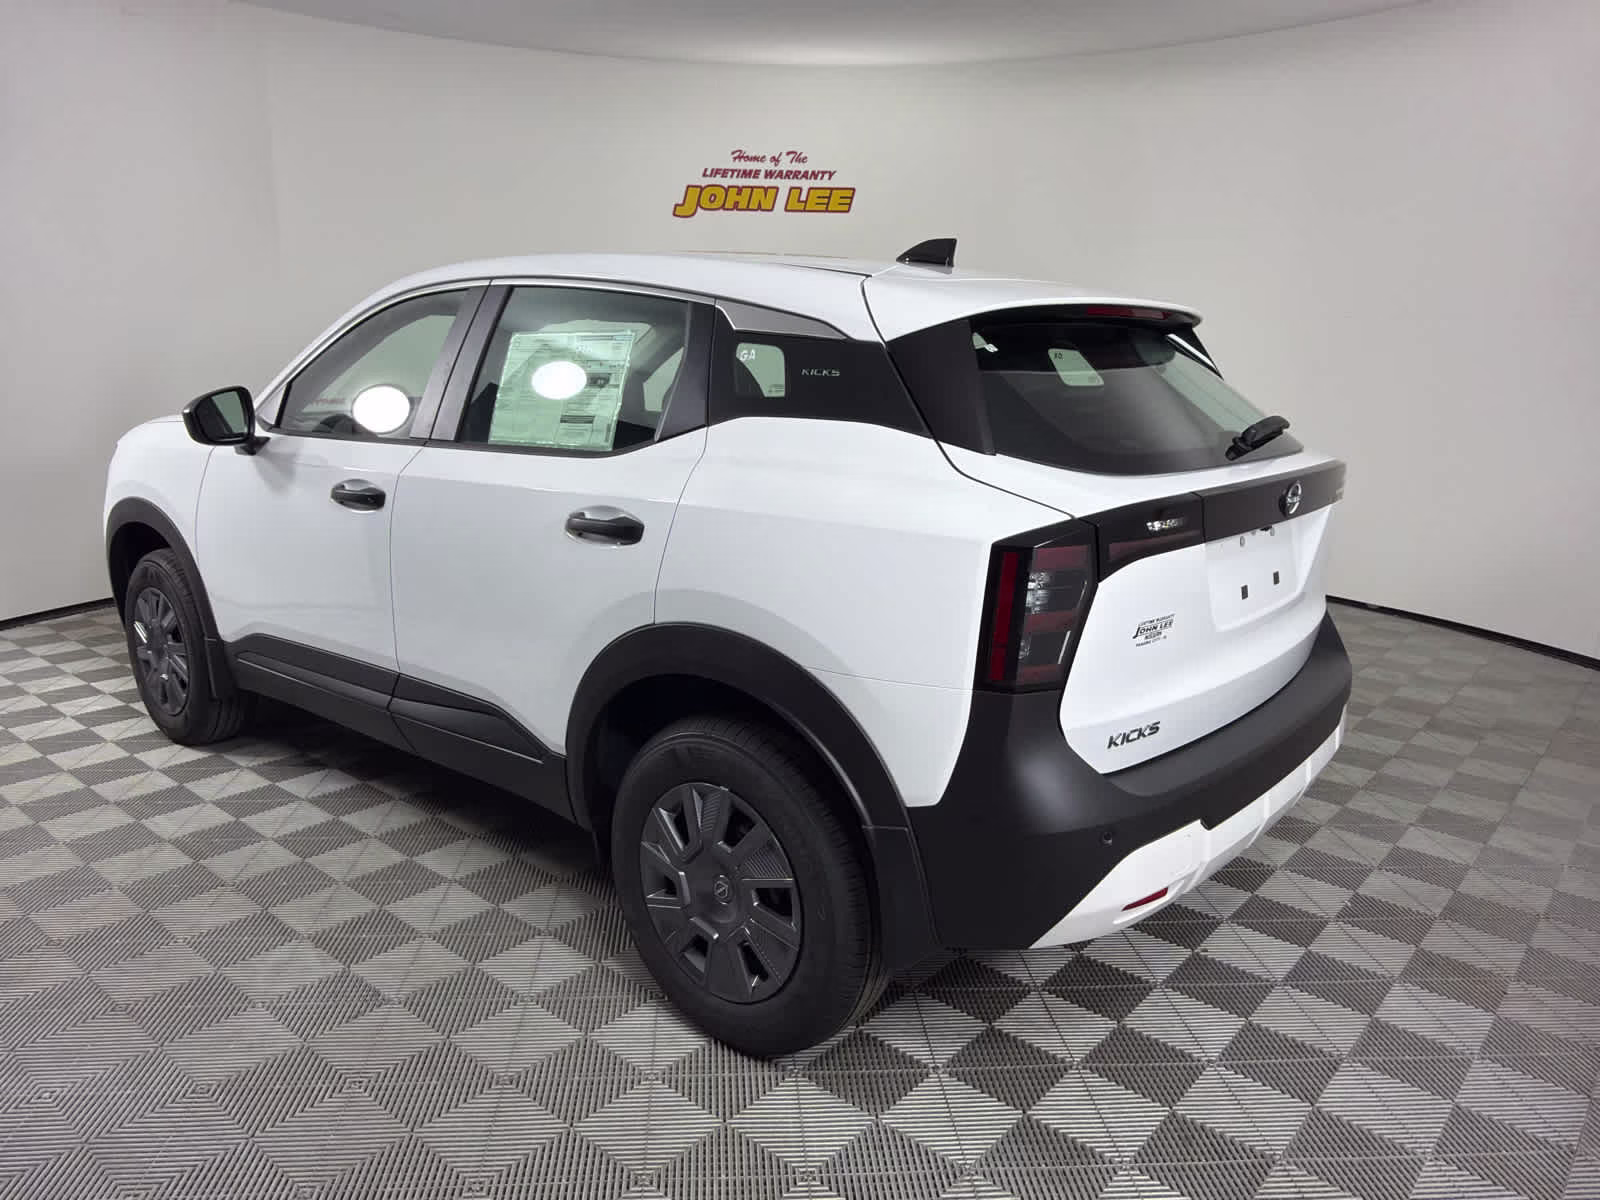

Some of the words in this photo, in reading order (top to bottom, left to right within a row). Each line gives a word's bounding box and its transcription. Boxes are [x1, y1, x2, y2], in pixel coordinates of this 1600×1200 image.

[730, 149, 766, 164] Home
[770, 152, 783, 166] of
[785, 150, 808, 164] The
[702, 167, 761, 180] LIFETIME
[764, 169, 837, 181] WARRANTY
[672, 184, 780, 218] JOHN
[784, 186, 856, 213] LEE
[801, 368, 841, 377] KICKS
[1107, 720, 1161, 750] KICKS
